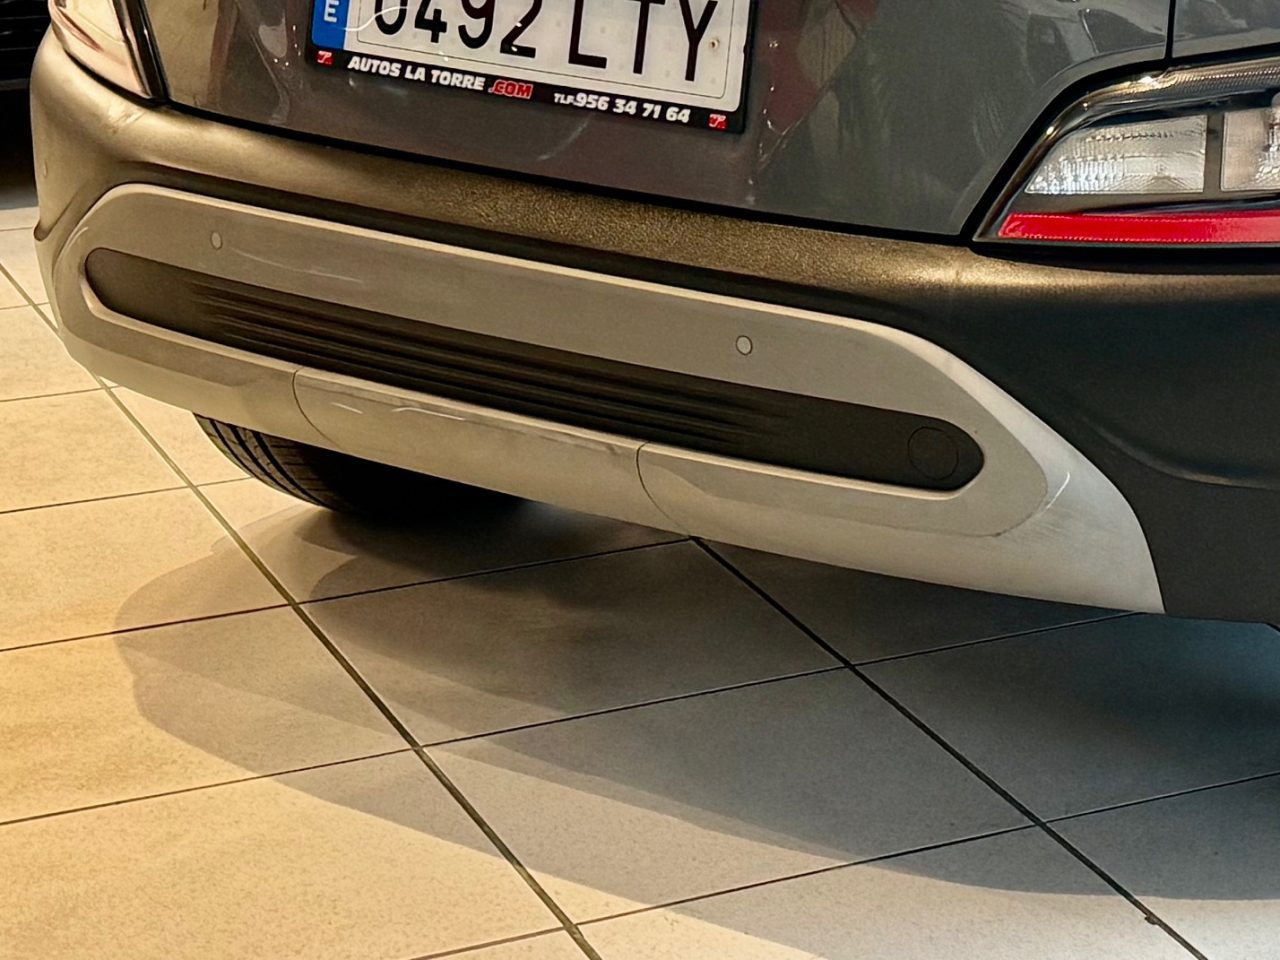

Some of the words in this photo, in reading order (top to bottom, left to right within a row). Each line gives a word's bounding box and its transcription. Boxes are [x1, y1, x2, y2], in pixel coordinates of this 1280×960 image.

[347, 55, 401, 78] AUTOS
[404, 65, 426, 82] LA
[430, 69, 486, 91] TORRE
[488, 79, 534, 100] .COM
[573, 91, 610, 112] 956
[612, 97, 637, 115] 34
[641, 102, 662, 119] 71
[665, 106, 691, 123] 64
